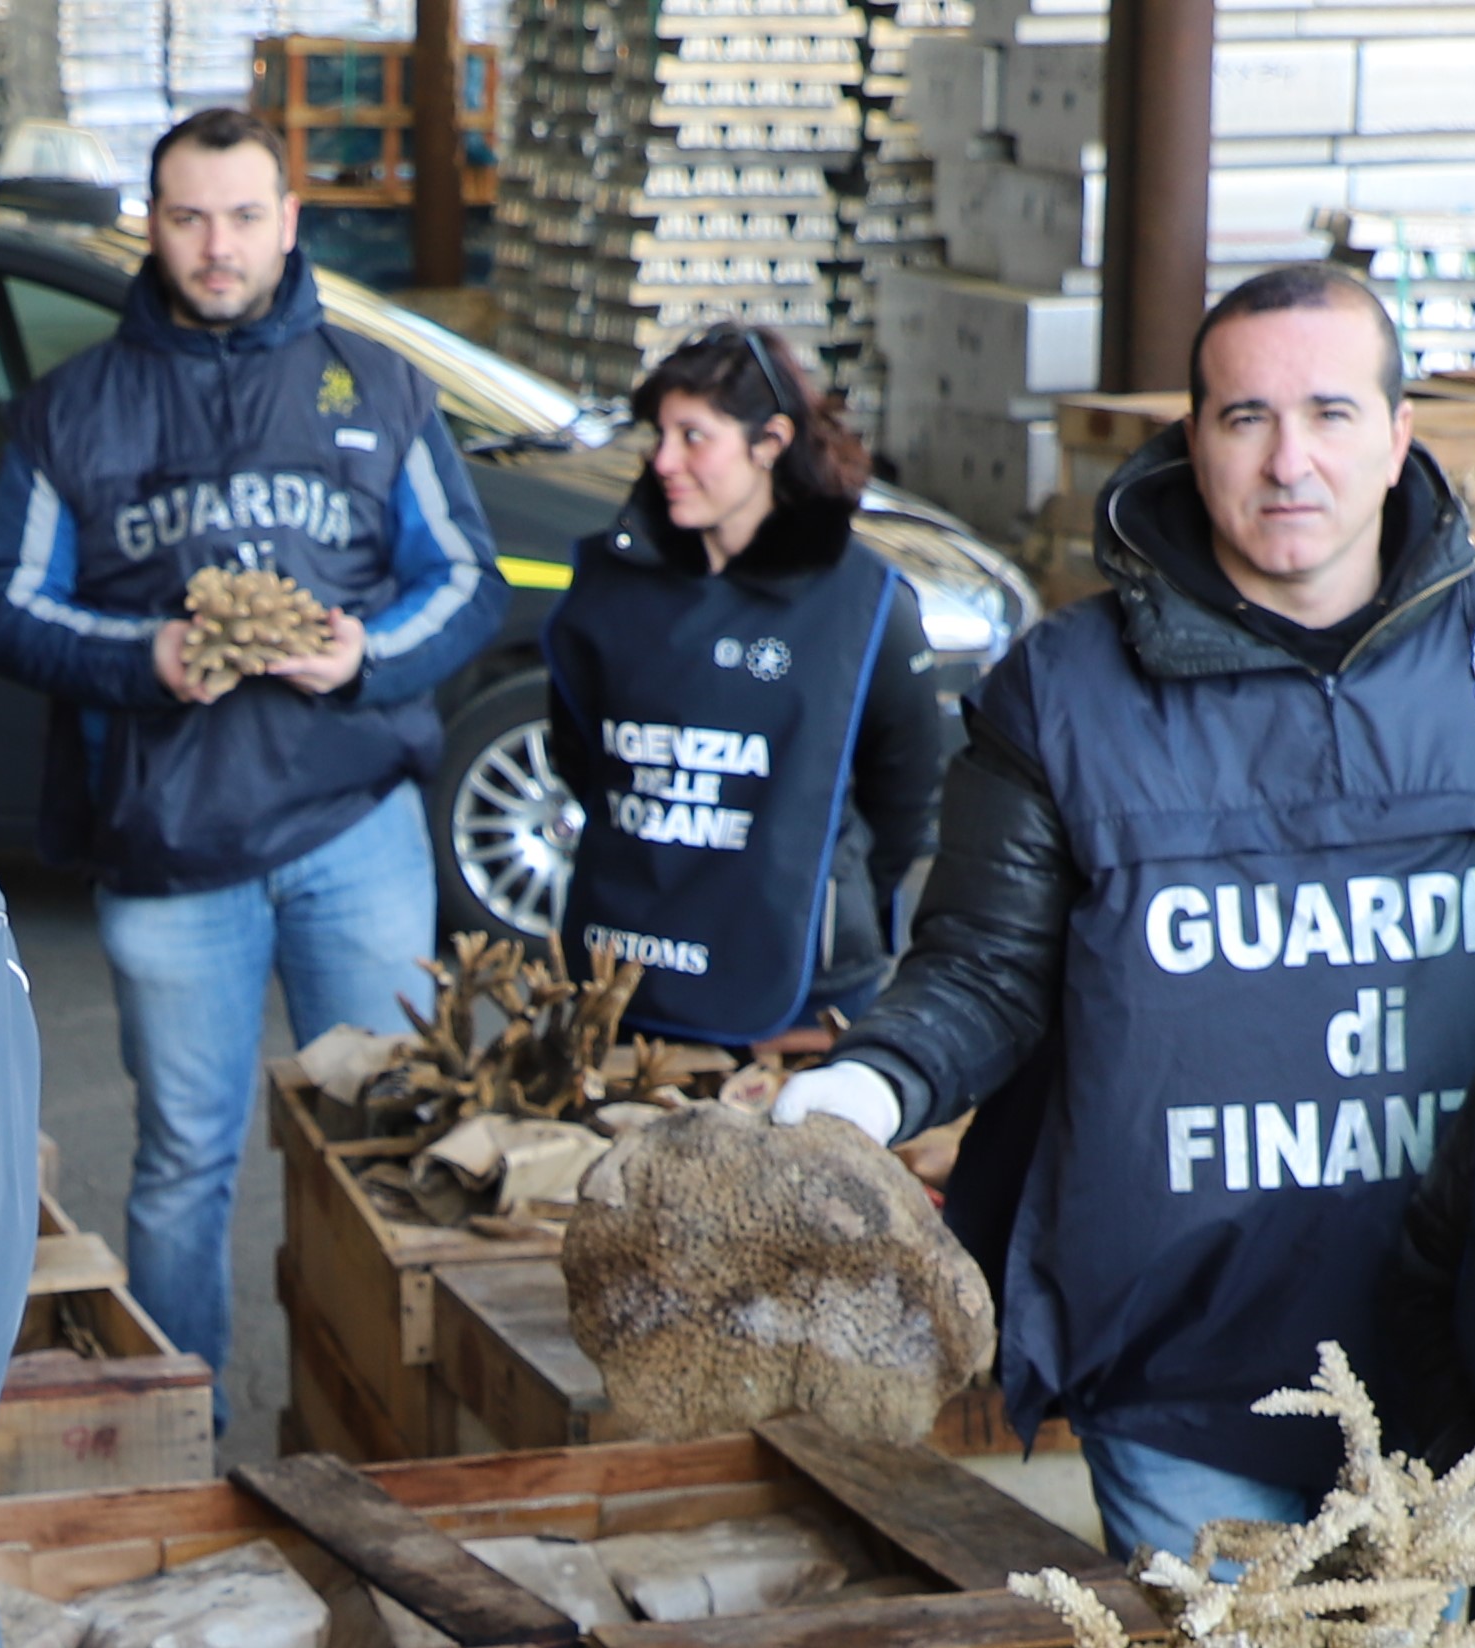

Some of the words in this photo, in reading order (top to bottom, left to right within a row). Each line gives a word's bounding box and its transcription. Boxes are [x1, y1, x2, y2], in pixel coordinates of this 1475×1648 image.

[116, 473, 351, 561] GUARDIA
[1326, 987, 1406, 1078] di
[1166, 1088, 1470, 1193] FINAN
